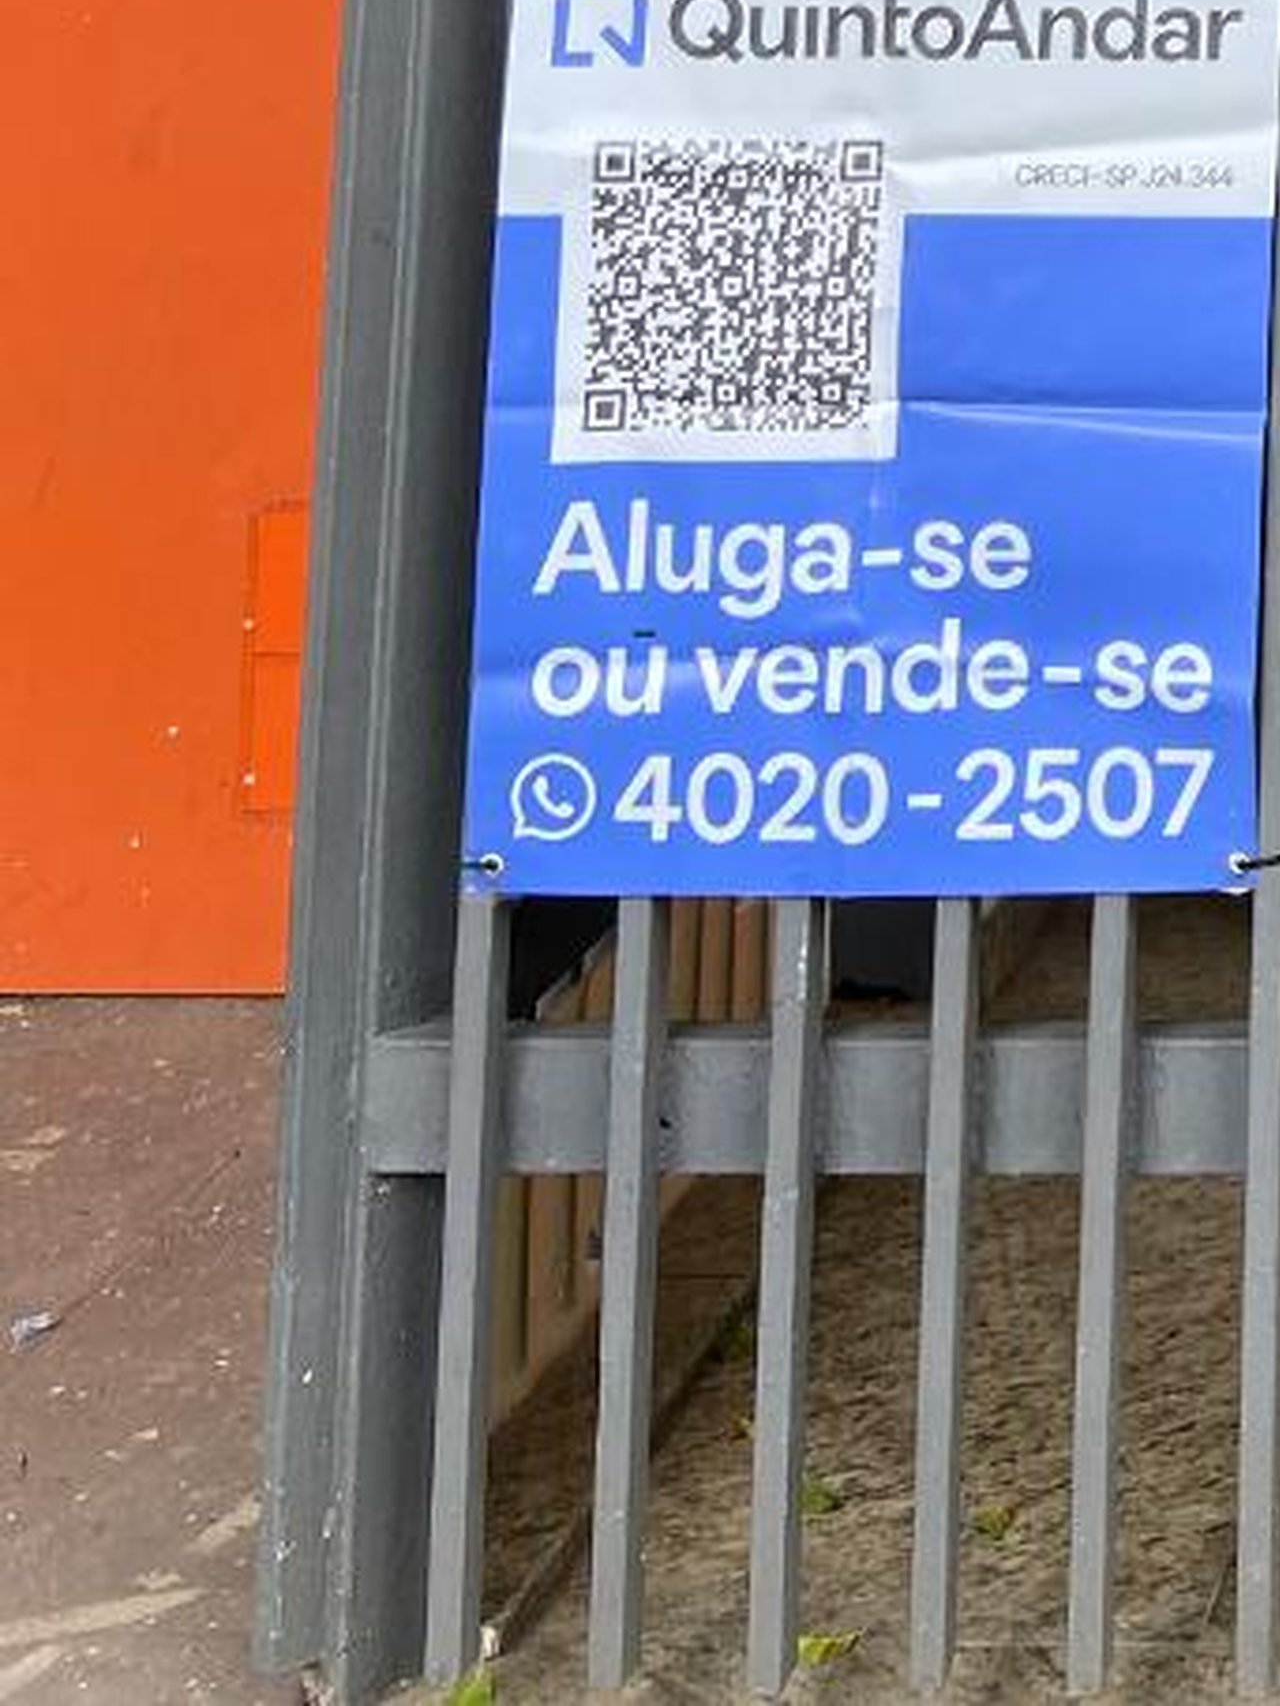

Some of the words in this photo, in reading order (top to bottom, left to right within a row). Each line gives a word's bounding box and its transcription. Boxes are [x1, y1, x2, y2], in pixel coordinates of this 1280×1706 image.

[532, 499, 1032, 619] Aluga-se
[531, 643, 665, 718] ou
[696, 618, 1214, 715] vende-se
[613, 747, 1215, 846] 4020-2507
